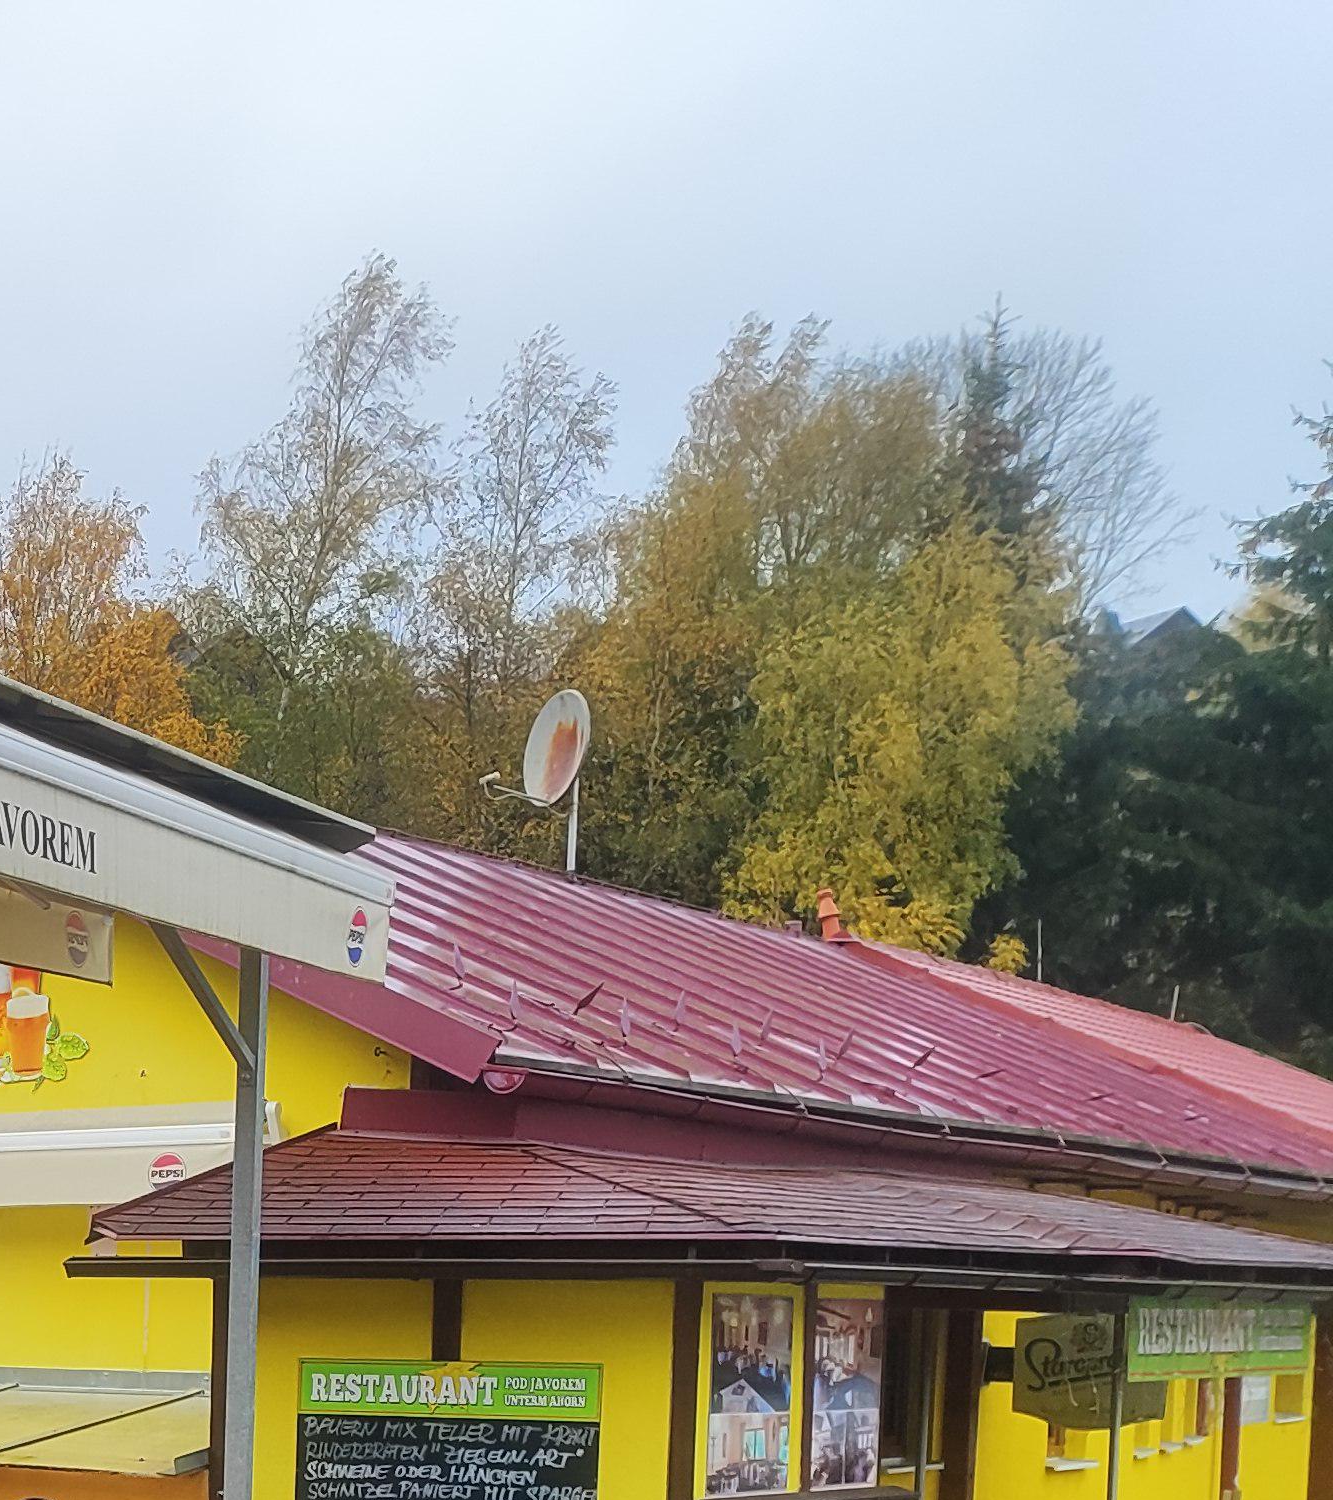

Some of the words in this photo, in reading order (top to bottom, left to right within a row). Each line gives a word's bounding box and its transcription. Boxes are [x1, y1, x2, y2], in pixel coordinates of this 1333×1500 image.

[150, 1168, 184, 1179] PEPSI
[310, 1372, 499, 1406] RESTAURANT
[504, 1376, 528, 1390] POD
[529, 1376, 586, 1393] JAVOREM
[504, 1394, 548, 1407] UNTERM
[548, 1395, 586, 1408] AHORN
[382, 1420, 418, 1439] MIX
[423, 1421, 497, 1445] TELLER
[500, 1424, 543, 1445] MIT
[394, 1464, 448, 1482] ODER
[397, 1480, 481, 1500] PANIERT
